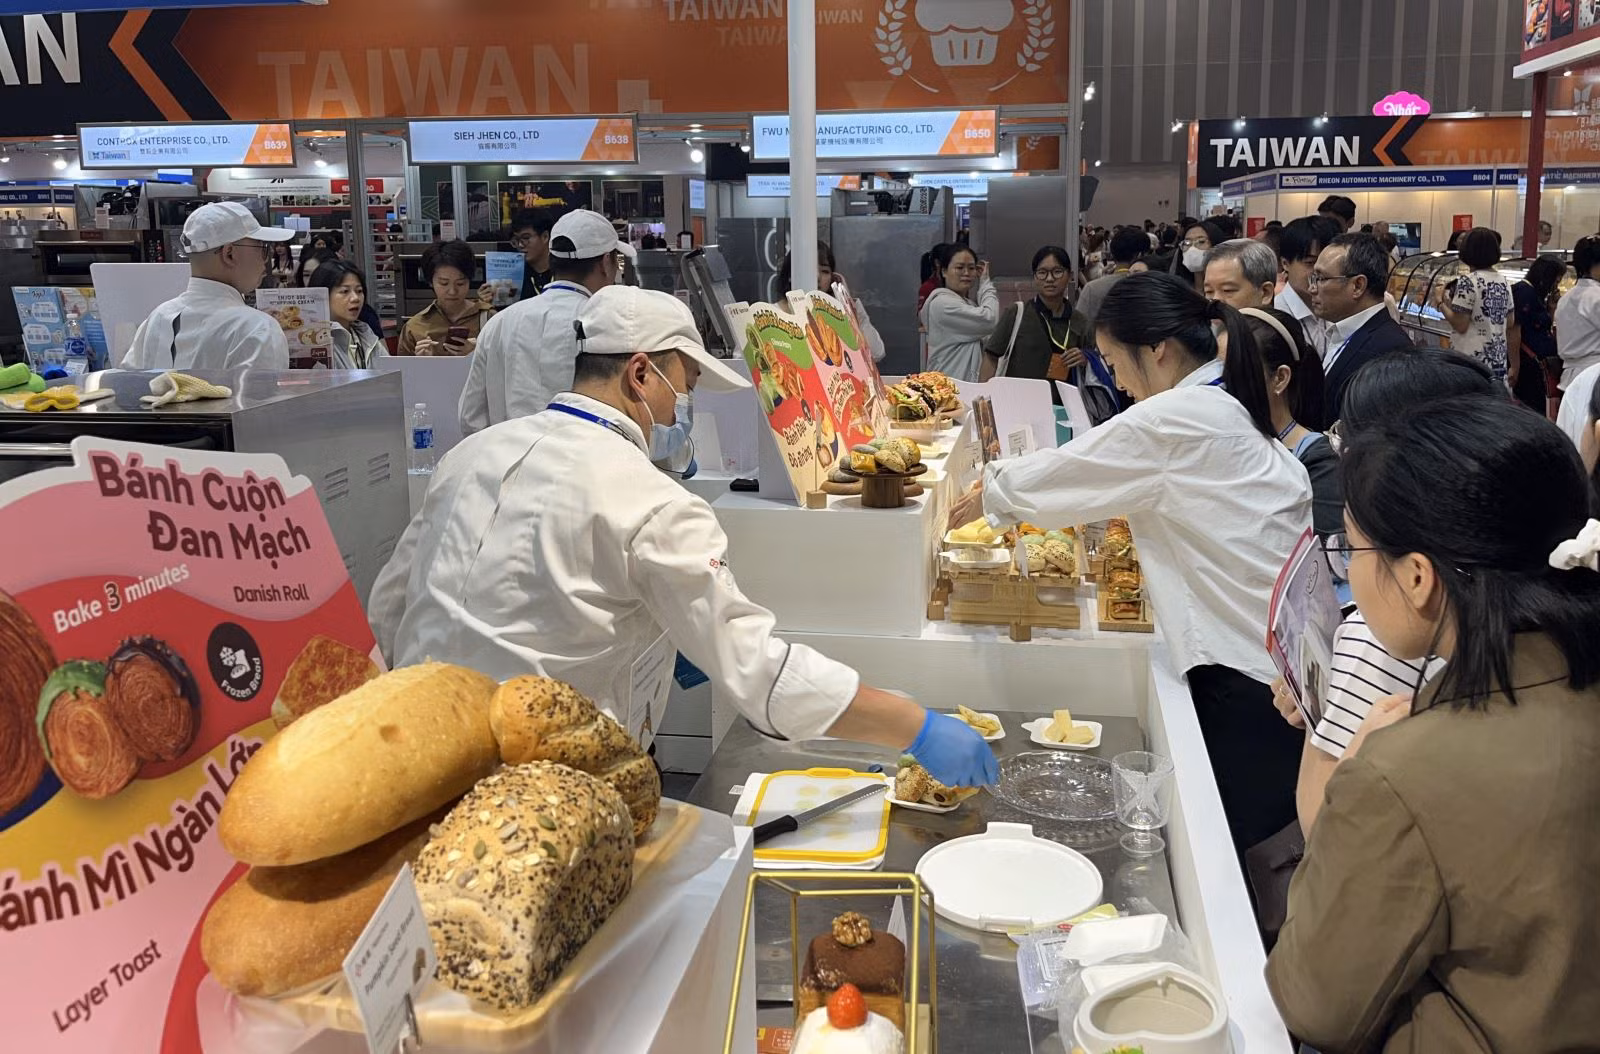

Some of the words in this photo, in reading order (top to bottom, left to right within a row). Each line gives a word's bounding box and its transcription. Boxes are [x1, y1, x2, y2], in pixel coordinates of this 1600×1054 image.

[816, 9, 863, 25] IWAN
[257, 44, 590, 119] TAIWAN
[454, 131, 474, 141] SIEH
[476, 131, 501, 140] JHEN
[503, 130, 521, 141] CO.,
[523, 130, 540, 139] LTD
[762, 127, 783, 136] FWU
[816, 125, 892, 135] ANUFACTURING
[894, 125, 913, 135] CO.,
[915, 124, 935, 134] LTD.
[964, 128, 991, 139] B650
[139, 136, 192, 146] ENTERPRISE
[212, 135, 231, 145] LTD.
[264, 140, 288, 150] B639
[604, 135, 629, 145] B638
[101, 151, 127, 160] Taiwan
[1210, 135, 1360, 168] TAIWAN
[1318, 177, 1340, 185] RHEON
[1341, 176, 1378, 184] AUTOMATIC
[1379, 175, 1415, 183] MACHINERY
[91, 455, 195, 506] Bánh
[202, 472, 286, 523] Cuộn
[147, 509, 224, 560] Đan
[228, 517, 312, 570] Mạch
[52, 598, 103, 634] Bake
[104, 582, 121, 611] 3
[124, 562, 191, 604] minutes
[233, 585, 281, 603] Danish
[283, 585, 310, 602] Roll
[221, 679, 252, 698] Frozen
[249, 657, 262, 691] Bread
[0, 868, 81, 932] ánh
[84, 849, 138, 911] Mì
[133, 795, 223, 885] Ngàn
[51, 981, 112, 1033] Layer
[108, 938, 163, 988] Toast
